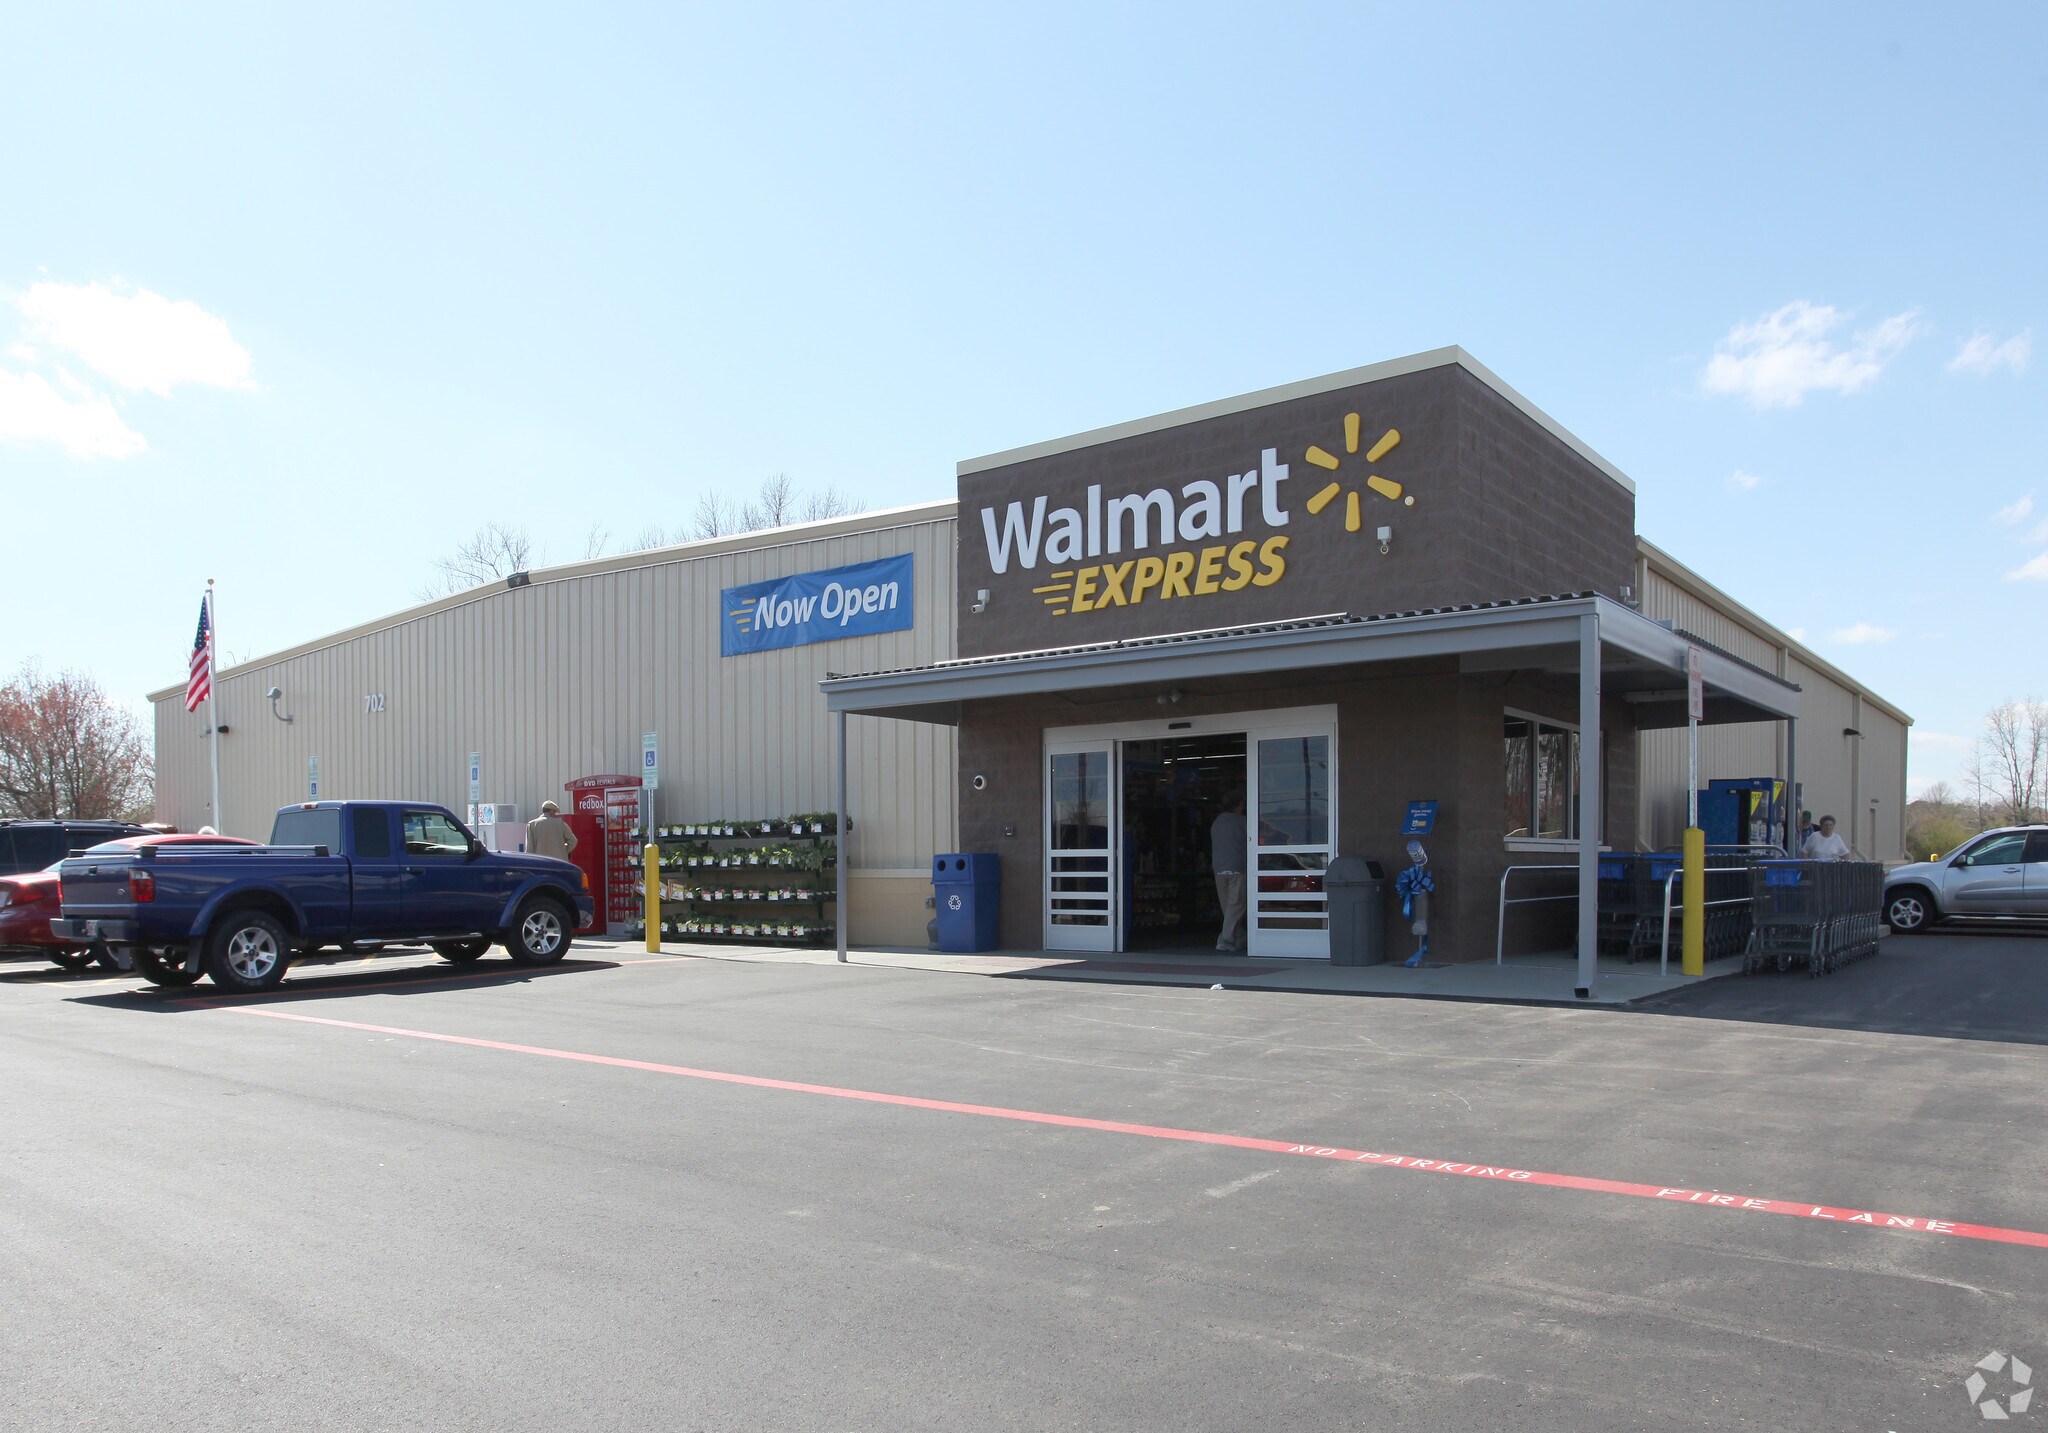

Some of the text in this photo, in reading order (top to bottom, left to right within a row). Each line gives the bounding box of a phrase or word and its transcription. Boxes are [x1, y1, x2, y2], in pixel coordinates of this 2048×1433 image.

[981, 447, 1290, 574] Walmart
[1071, 535, 1290, 613] EXPRESS
[754, 581, 899, 631] Now Open
[364, 693, 385, 713] 702
[579, 798, 605, 810] redbox
[596, 778, 616, 786] RENTALS
[1288, 1144, 1956, 1233] NO PARKING FIRE LANE
